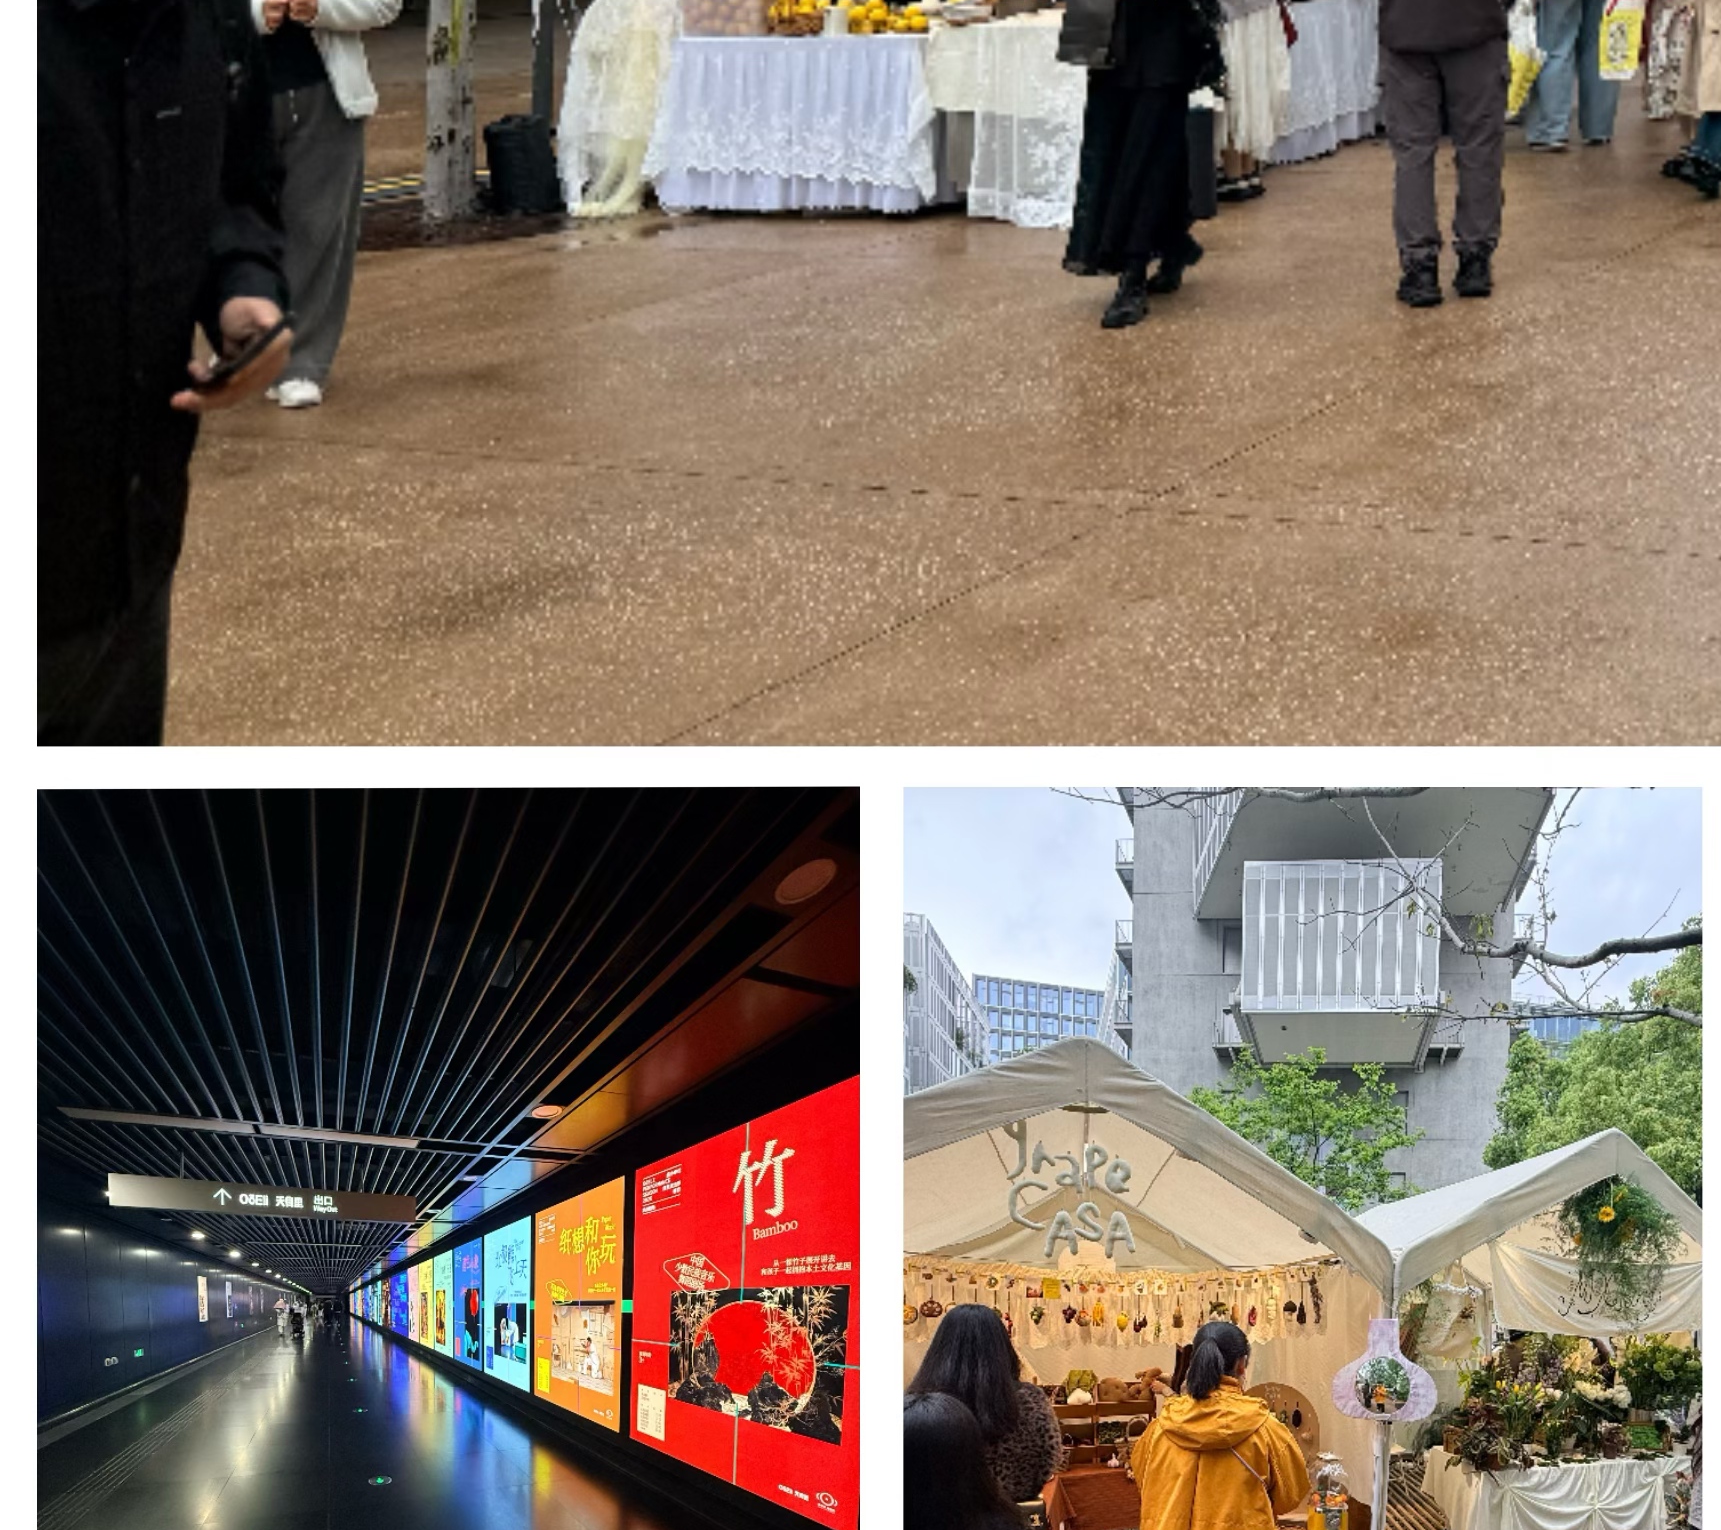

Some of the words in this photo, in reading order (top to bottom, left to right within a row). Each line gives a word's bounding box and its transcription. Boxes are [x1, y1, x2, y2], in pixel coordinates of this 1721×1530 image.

[313, 1194, 333, 1206] 出口
[732, 1138, 796, 1226] 竹
[753, 1220, 798, 1241] Bamboo
[1008, 1179, 1136, 1258] CASA
